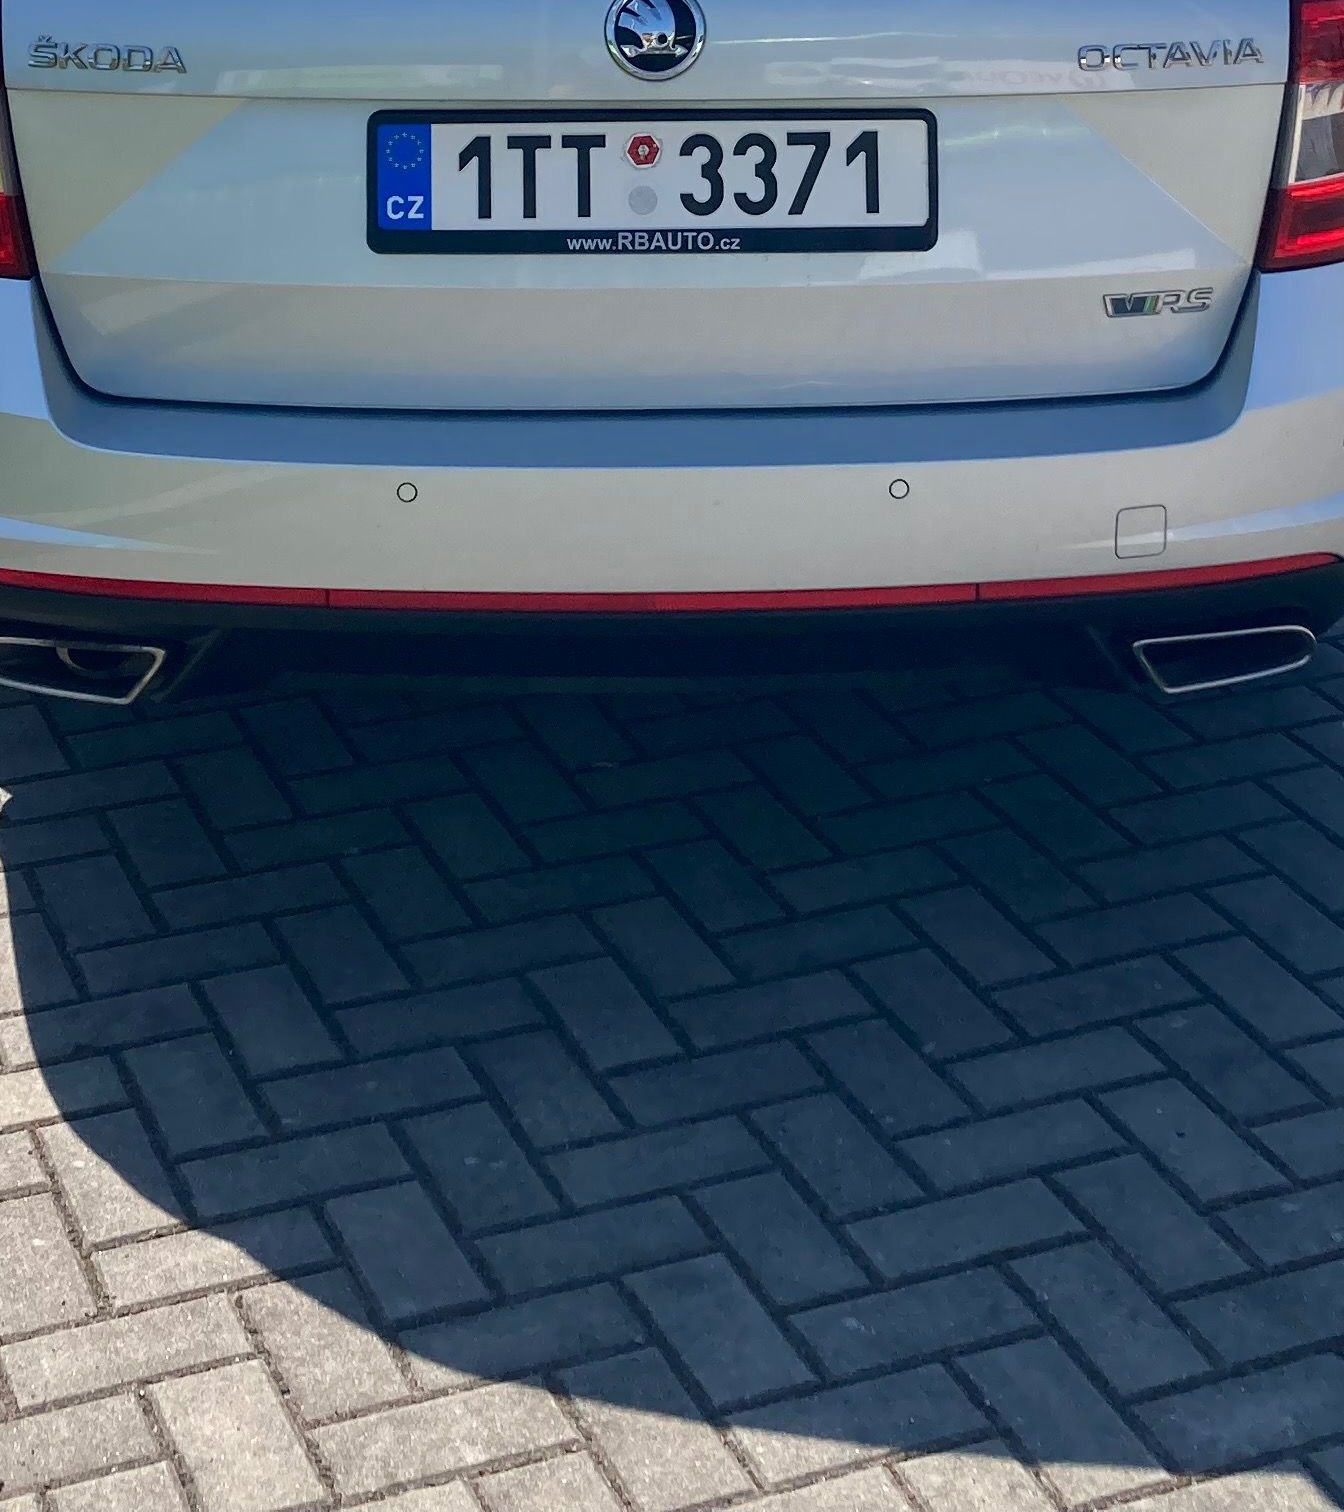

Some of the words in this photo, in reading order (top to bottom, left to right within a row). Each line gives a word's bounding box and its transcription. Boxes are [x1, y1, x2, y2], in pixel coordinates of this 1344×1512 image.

[27, 35, 188, 74] ŠKODA
[1077, 37, 1265, 72] OCTAVIA
[459, 135, 606, 219] 1TT
[679, 131, 880, 216] 3371
[386, 195, 425, 220] CZ
[566, 232, 741, 251] www.RBAUTO.cz
